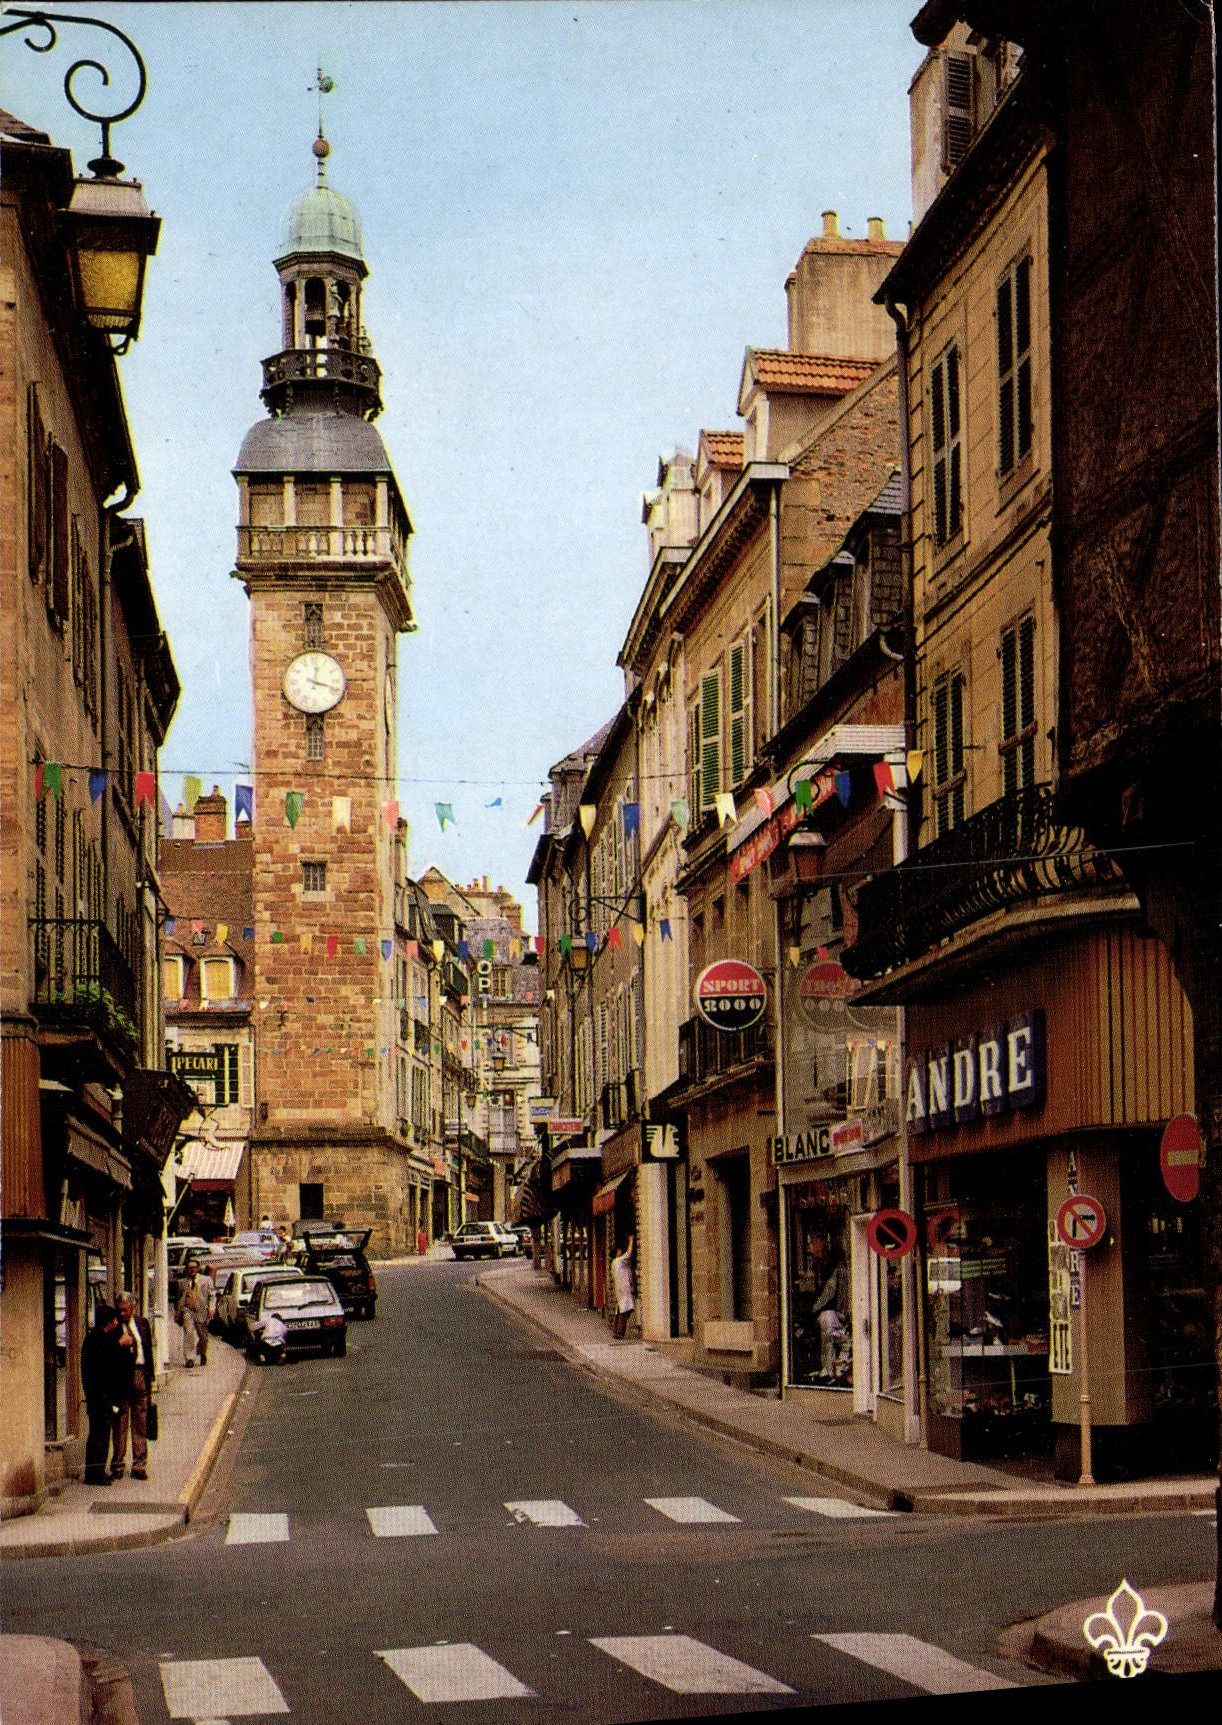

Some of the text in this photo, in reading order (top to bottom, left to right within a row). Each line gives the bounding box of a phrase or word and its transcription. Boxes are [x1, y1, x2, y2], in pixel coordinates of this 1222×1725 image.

[703, 979, 761, 993] SPORT
[704, 998, 762, 1012] 2000
[906, 1026, 1032, 1122] ANDRE
[774, 1128, 830, 1162] BLANC
